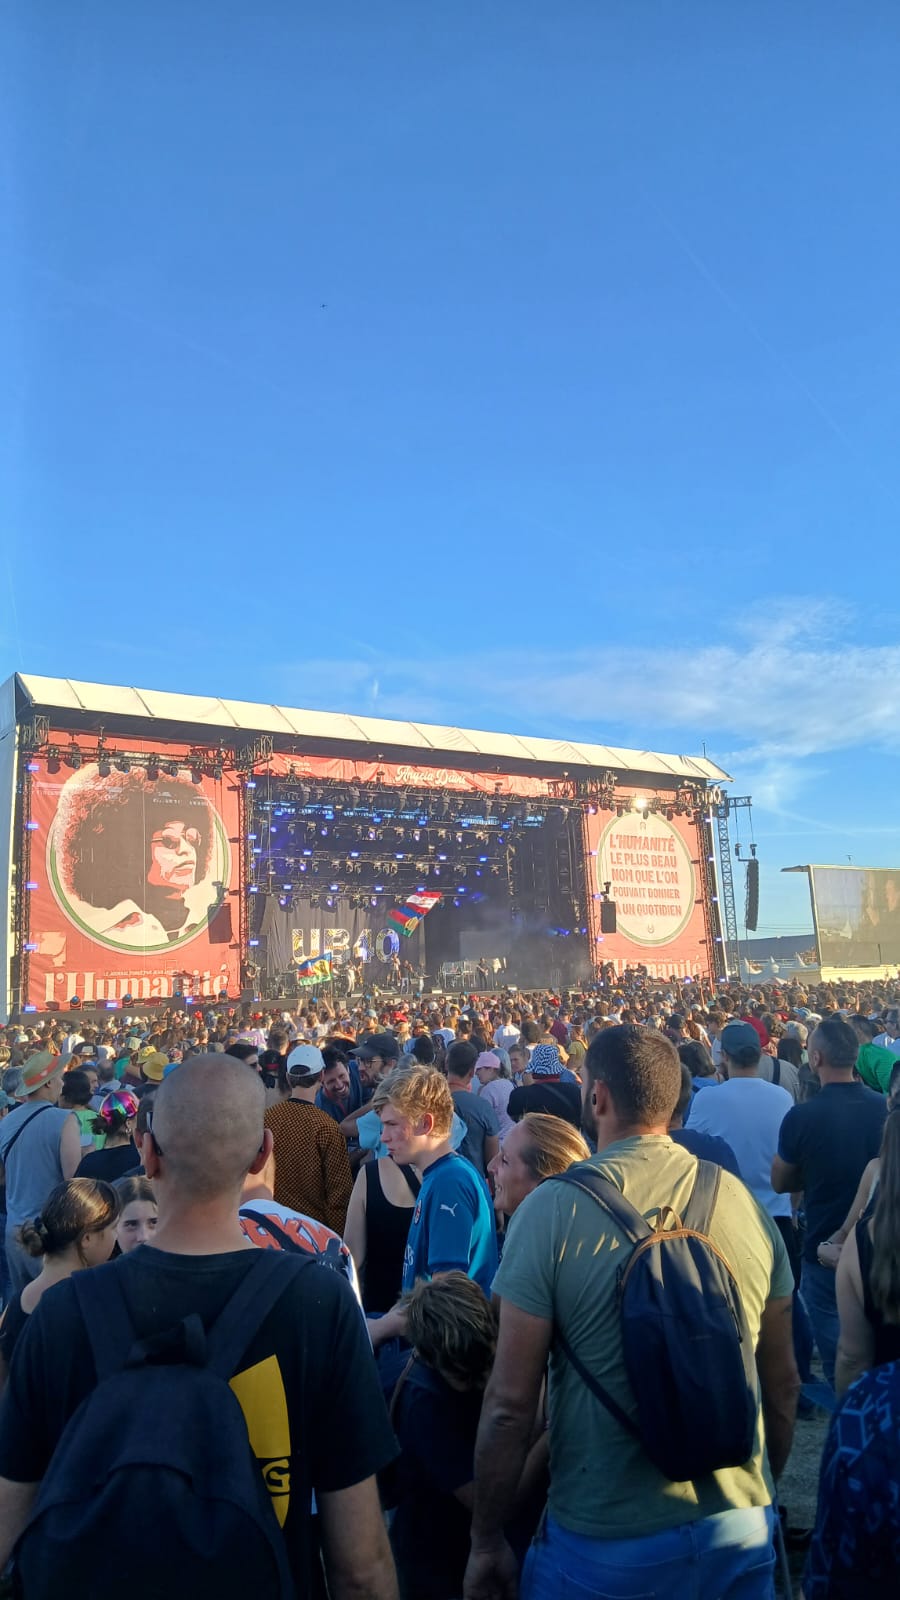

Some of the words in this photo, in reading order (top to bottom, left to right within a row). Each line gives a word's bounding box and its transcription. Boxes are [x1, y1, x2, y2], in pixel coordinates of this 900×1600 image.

[609, 833, 675, 852] L'HUMANITÉ
[610, 852, 623, 865] LE
[624, 853, 649, 868] PLUS
[651, 855, 677, 868] BEAU
[611, 868, 633, 882] NOM
[635, 869, 655, 884] QUE
[656, 870, 679, 884] L'ON
[613, 886, 646, 897] POUVAIT
[647, 888, 680, 899] DONNER
[622, 903, 635, 915] UN
[636, 903, 682, 917] QUOTIDIEN
[292, 928, 399, 964] UB40
